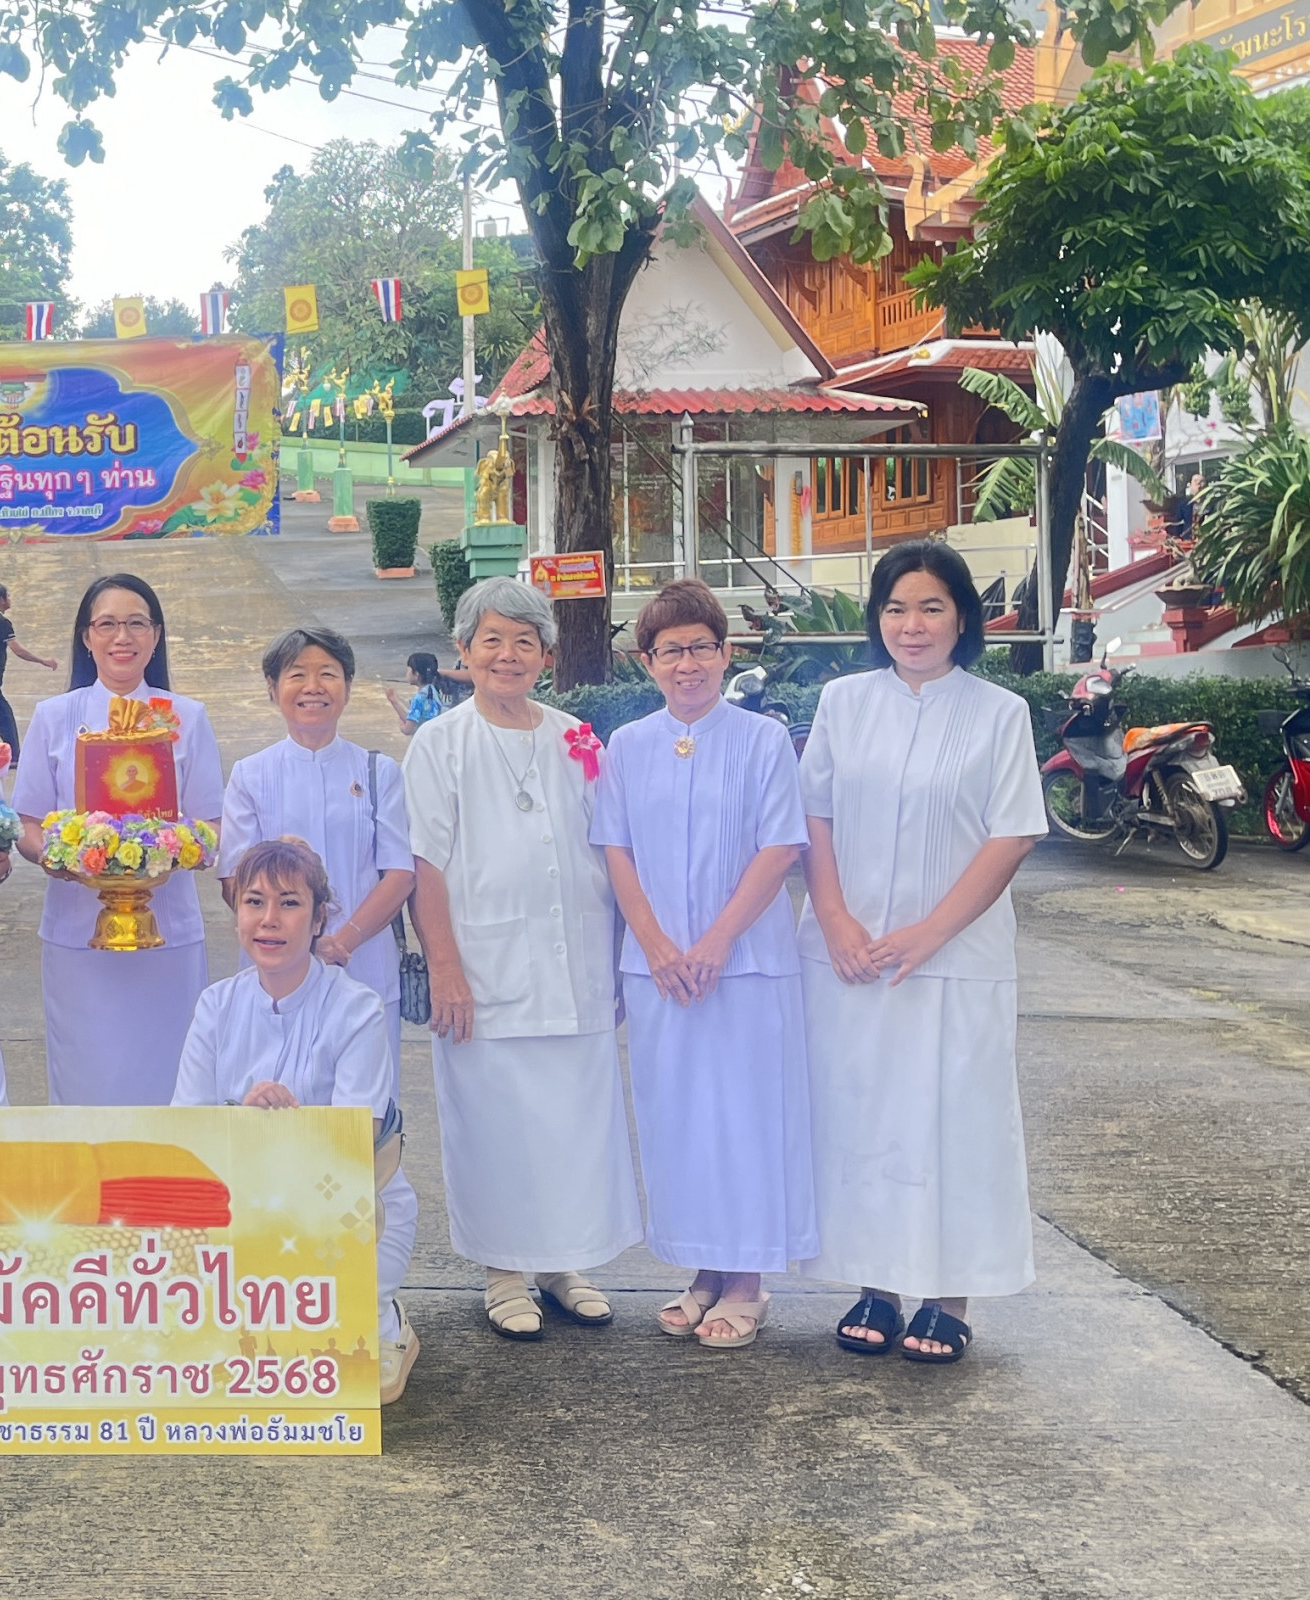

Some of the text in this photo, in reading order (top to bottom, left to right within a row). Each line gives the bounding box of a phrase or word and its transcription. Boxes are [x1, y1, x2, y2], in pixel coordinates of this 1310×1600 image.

[1219, 9, 1310, 59] ัฒนะโร
[101, 460, 156, 489] ท่าน
[228, 1359, 337, 1394] 2568
[100, 1421, 128, 1441] 81
[138, 1416, 155, 1441] ปี
[166, 1415, 363, 1441] หลวงพ่อธัมมชโย
